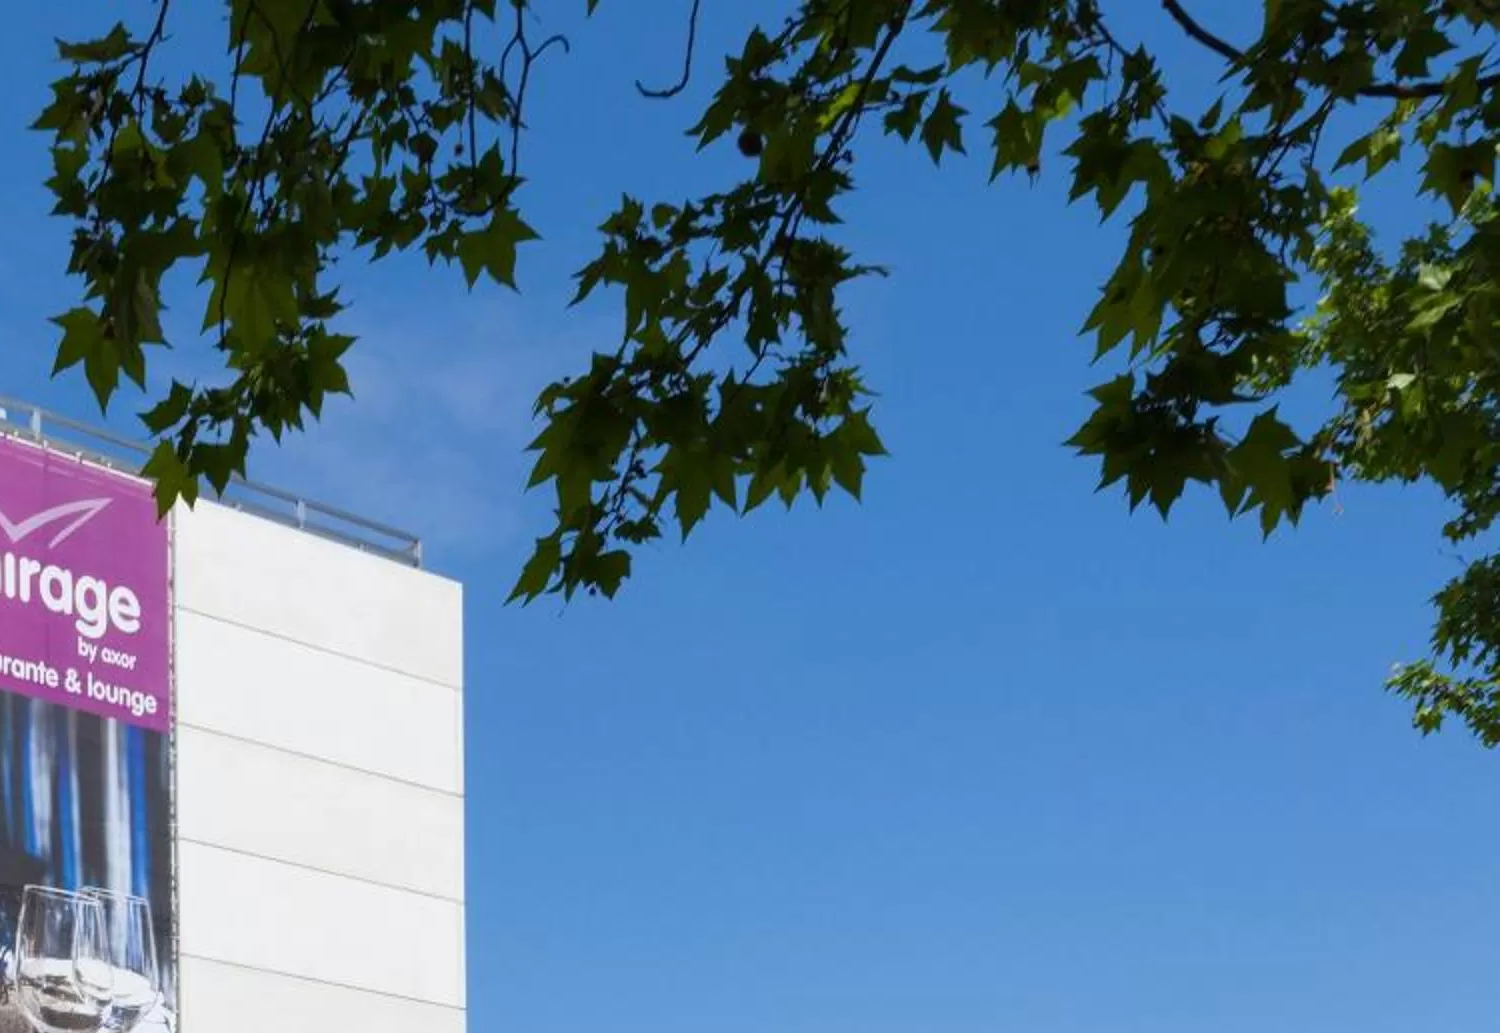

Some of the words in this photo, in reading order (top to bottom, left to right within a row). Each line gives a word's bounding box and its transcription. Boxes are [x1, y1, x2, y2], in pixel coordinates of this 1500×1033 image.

[77, 637, 97, 662] by
[102, 648, 137, 670] axor
[65, 668, 82, 694] &
[88, 672, 157, 715] lounge
